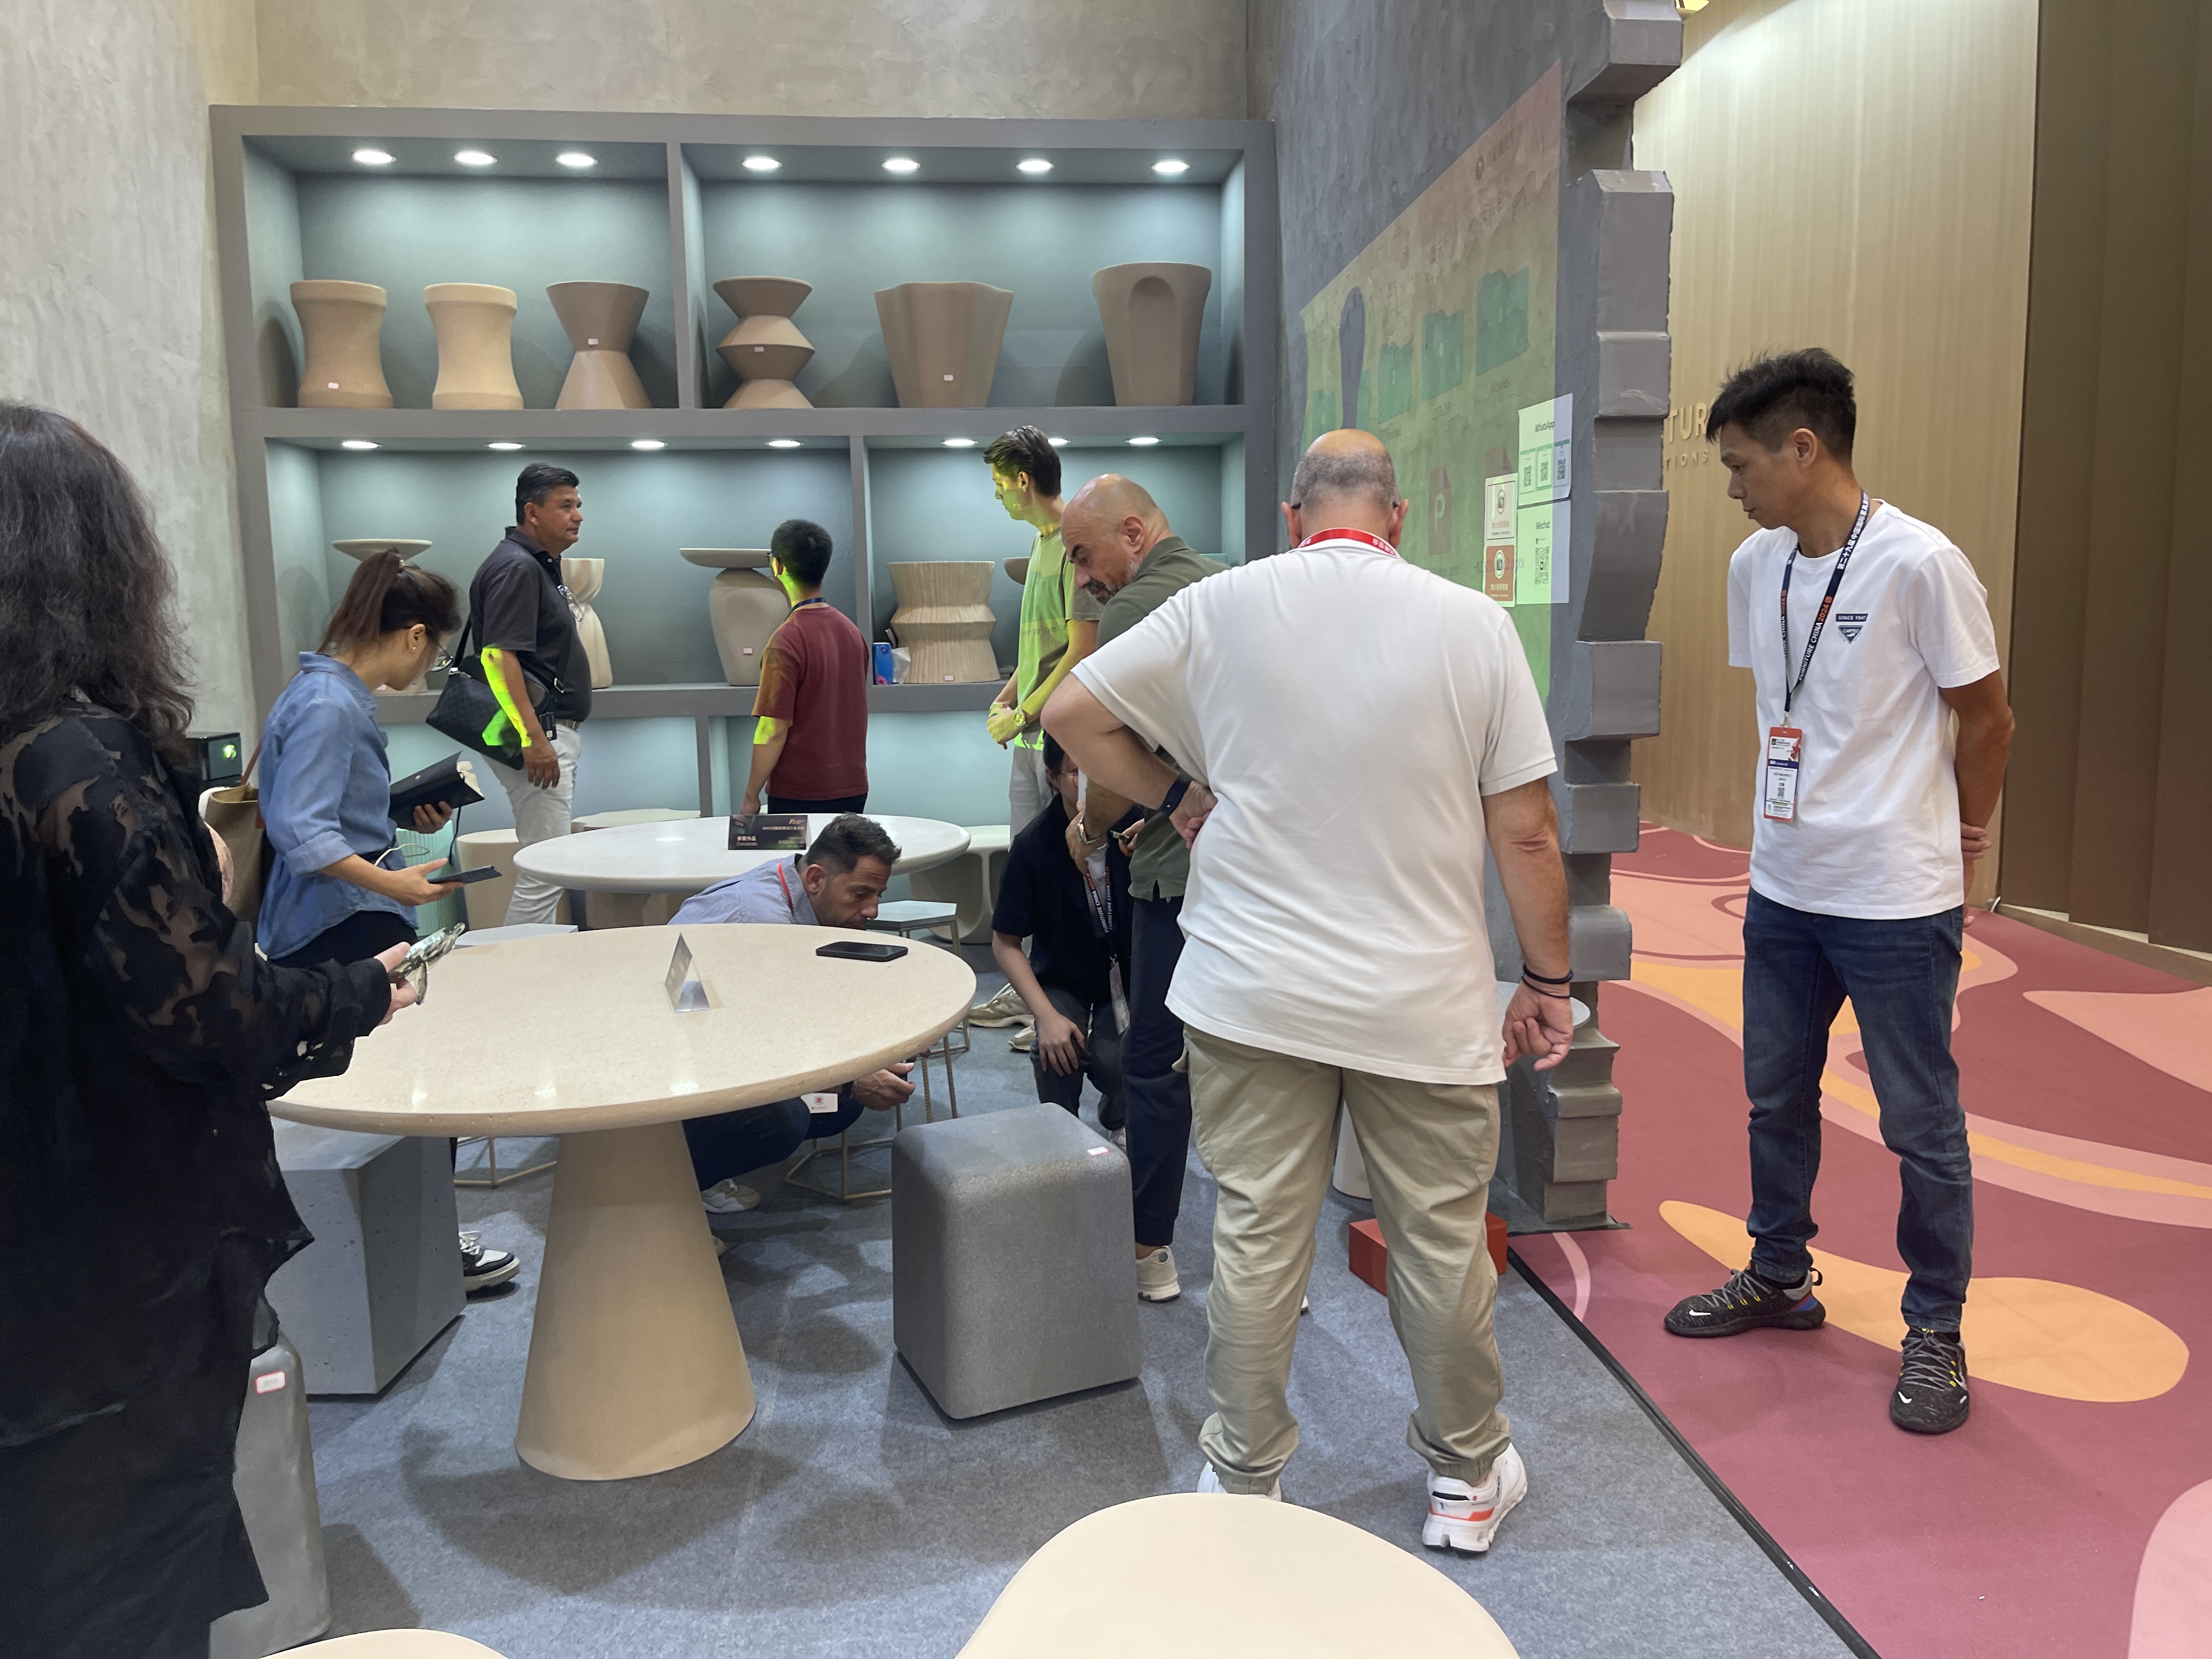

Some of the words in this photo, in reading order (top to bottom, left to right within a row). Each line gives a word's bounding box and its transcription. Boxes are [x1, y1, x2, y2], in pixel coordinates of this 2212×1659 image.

[1668, 398, 1716, 442] TUR
[1799, 644, 1815, 681] FURNITURE
[1810, 622, 1822, 643] CHINA
[1818, 604, 1830, 622] 2024
